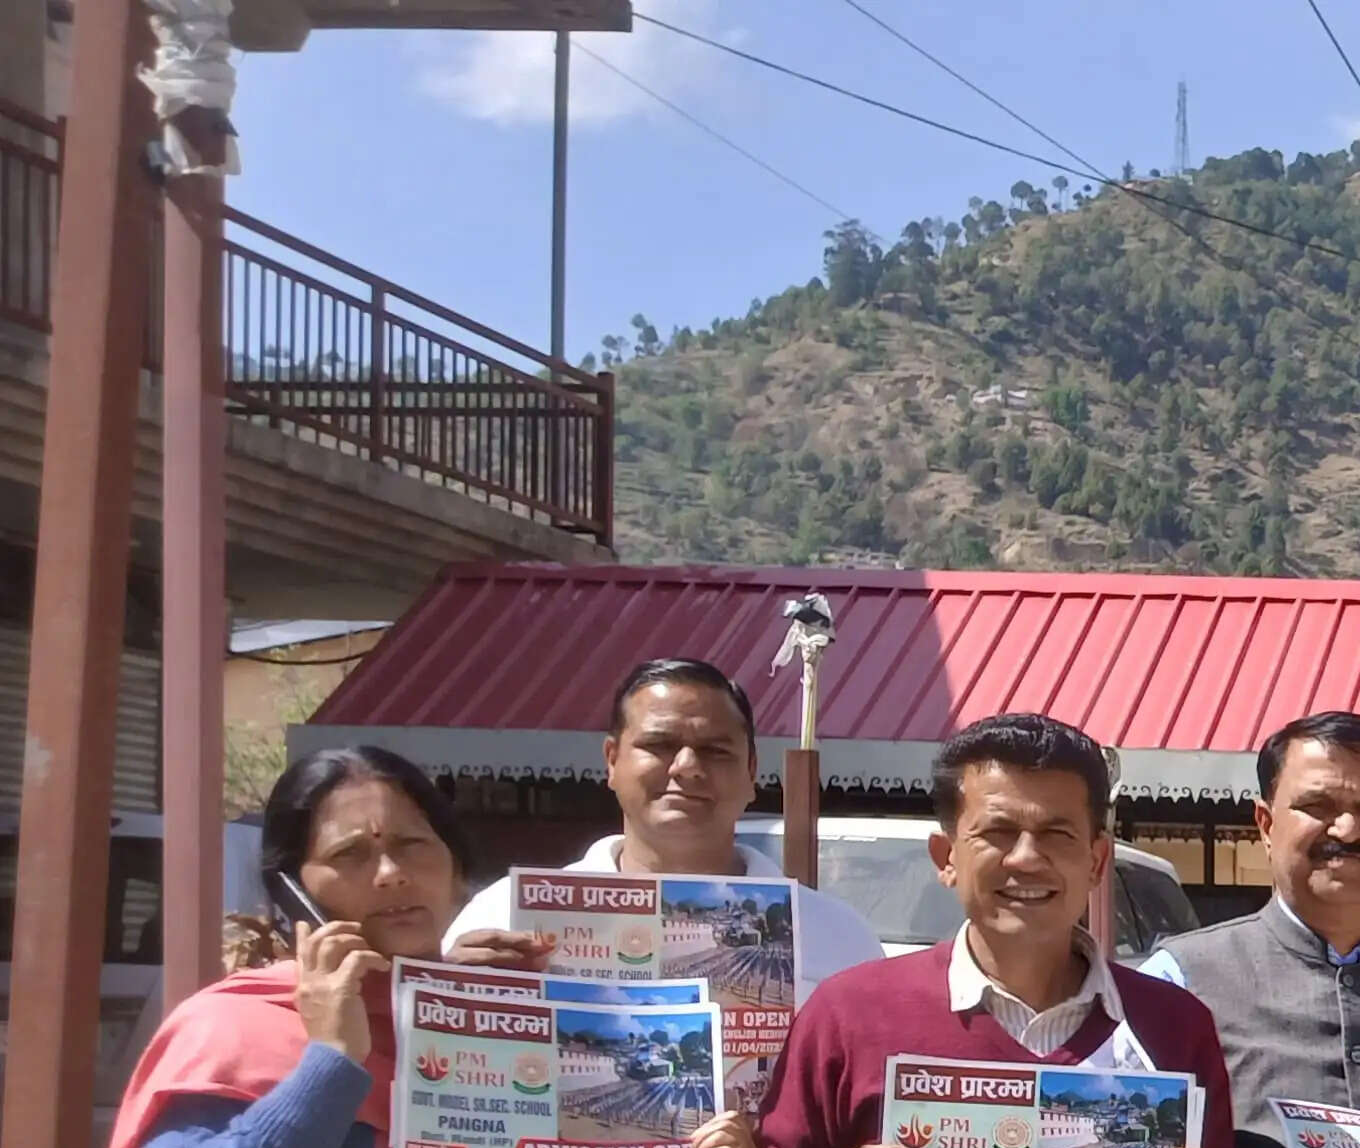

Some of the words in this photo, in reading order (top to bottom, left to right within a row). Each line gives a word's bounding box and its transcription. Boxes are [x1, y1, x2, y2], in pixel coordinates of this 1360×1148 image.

[523, 879, 575, 907] प्रवेश
[582, 885, 656, 908] प्रारम्भ
[564, 926, 593, 939] PM
[563, 943, 611, 959] SHRI
[416, 999, 467, 1029] प्रवेश
[473, 1009, 550, 1036] प्रारम्भ
[743, 1011, 790, 1027] OPEN
[456, 1051, 486, 1067] PM
[455, 1070, 505, 1088] SHRI
[900, 1069, 954, 1097] प्रवेश
[960, 1076, 1034, 1100] प्रारम्भ
[514, 1100, 552, 1116] SCHOOL
[438, 1116, 506, 1133] PANGNA
[939, 1117, 970, 1133] PM
